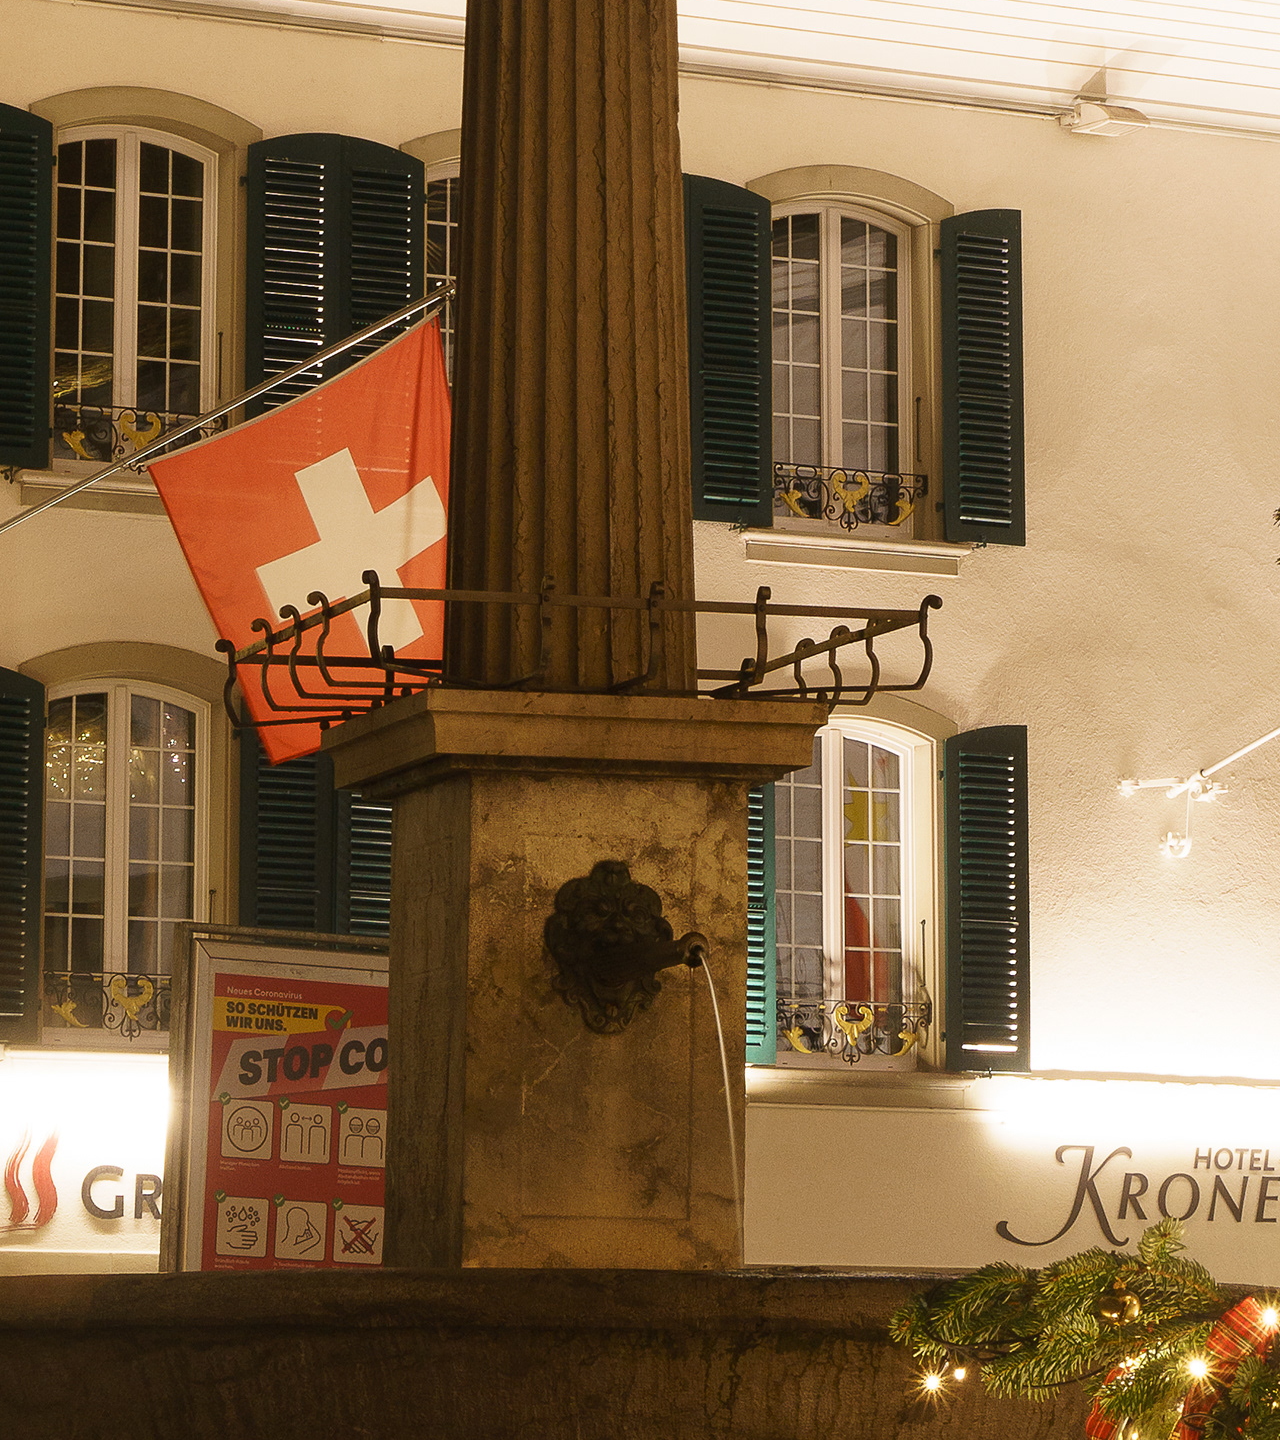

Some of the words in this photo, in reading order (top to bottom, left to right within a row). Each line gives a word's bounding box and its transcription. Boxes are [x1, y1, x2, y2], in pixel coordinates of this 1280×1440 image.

[226, 986, 253, 996] Neues
[253, 987, 303, 1000] Coronavirus
[226, 1001, 246, 1014] SO
[247, 1002, 319, 1020] SCHÜTZEN
[226, 1016, 253, 1029] WIR
[255, 1017, 288, 1032] UNS.
[238, 1043, 333, 1086] STOP
[339, 1037, 388, 1075] CO
[1193, 1147, 1275, 1171] HOTEL
[81, 1165, 162, 1220] GR
